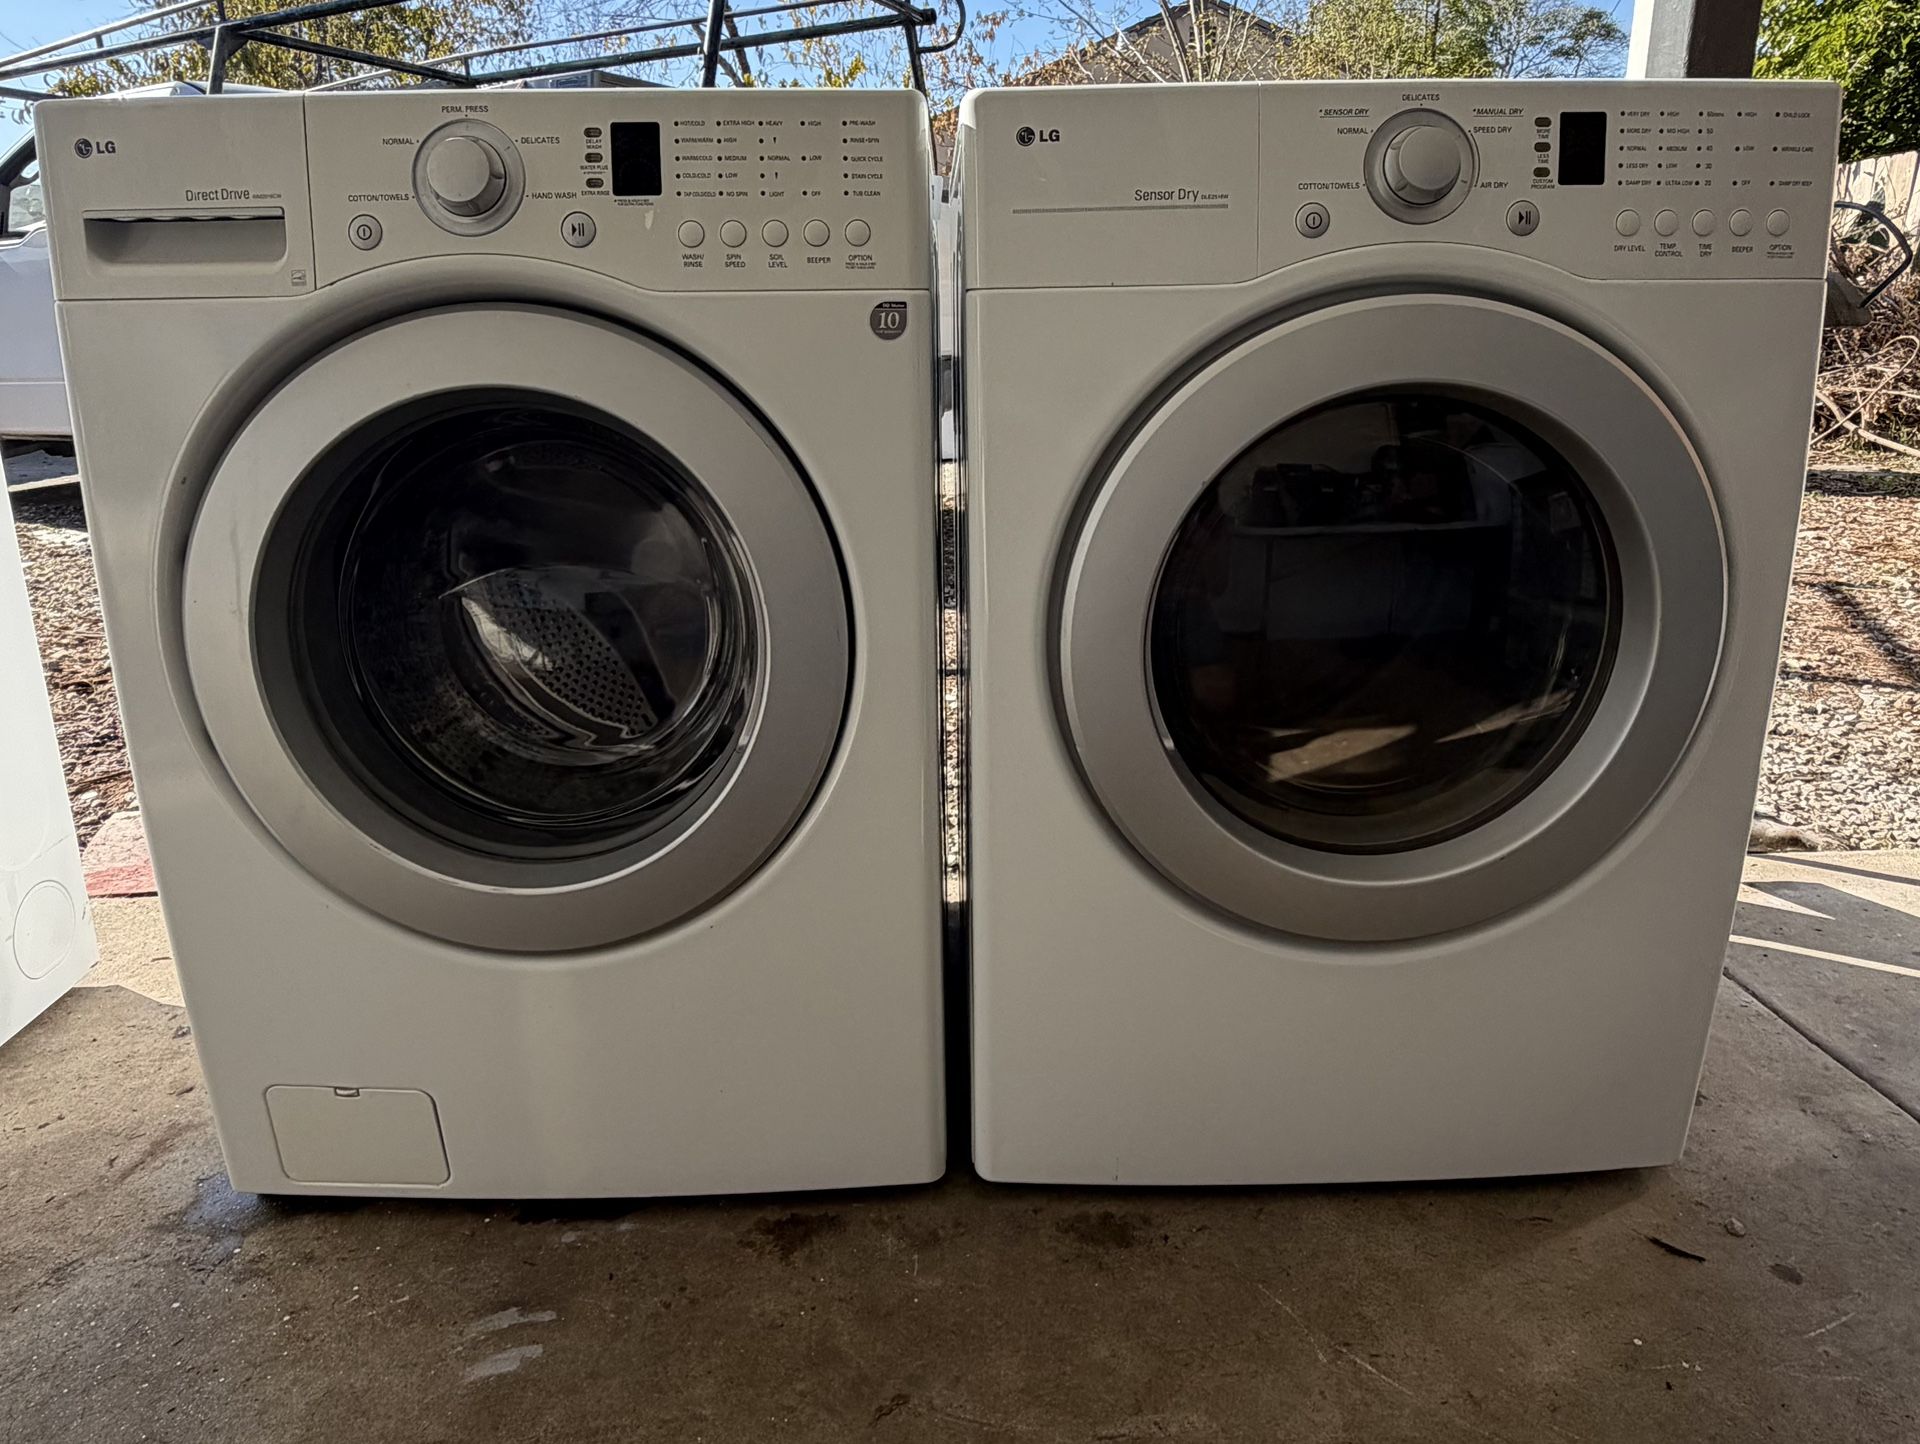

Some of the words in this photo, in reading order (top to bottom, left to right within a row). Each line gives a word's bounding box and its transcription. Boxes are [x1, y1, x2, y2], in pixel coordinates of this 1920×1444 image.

[1402, 94, 1440, 102] DELICATES
[441, 105, 464, 113] PERM.
[466, 105, 489, 113] PRESS
[1323, 108, 1353, 116] SENSOR
[1337, 127, 1368, 135] NORMAL
[1473, 126, 1496, 134] SPEED
[520, 136, 560, 144] DELICATES
[1039, 130, 1060, 142] LG
[382, 137, 414, 145] NORMAL
[96, 141, 116, 154] LG
[1298, 182, 1360, 190] COTTON/TOWELS
[185, 189, 220, 202] Direct
[221, 188, 250, 200] Drive
[348, 194, 410, 202] COTTON/TOWELS
[531, 192, 552, 200] HAND
[554, 192, 577, 200] WASH
[1134, 189, 1175, 201] Sensor
[1178, 188, 1200, 202] Dry
[807, 256, 831, 264] BEEPER
[879, 311, 900, 329] 10
